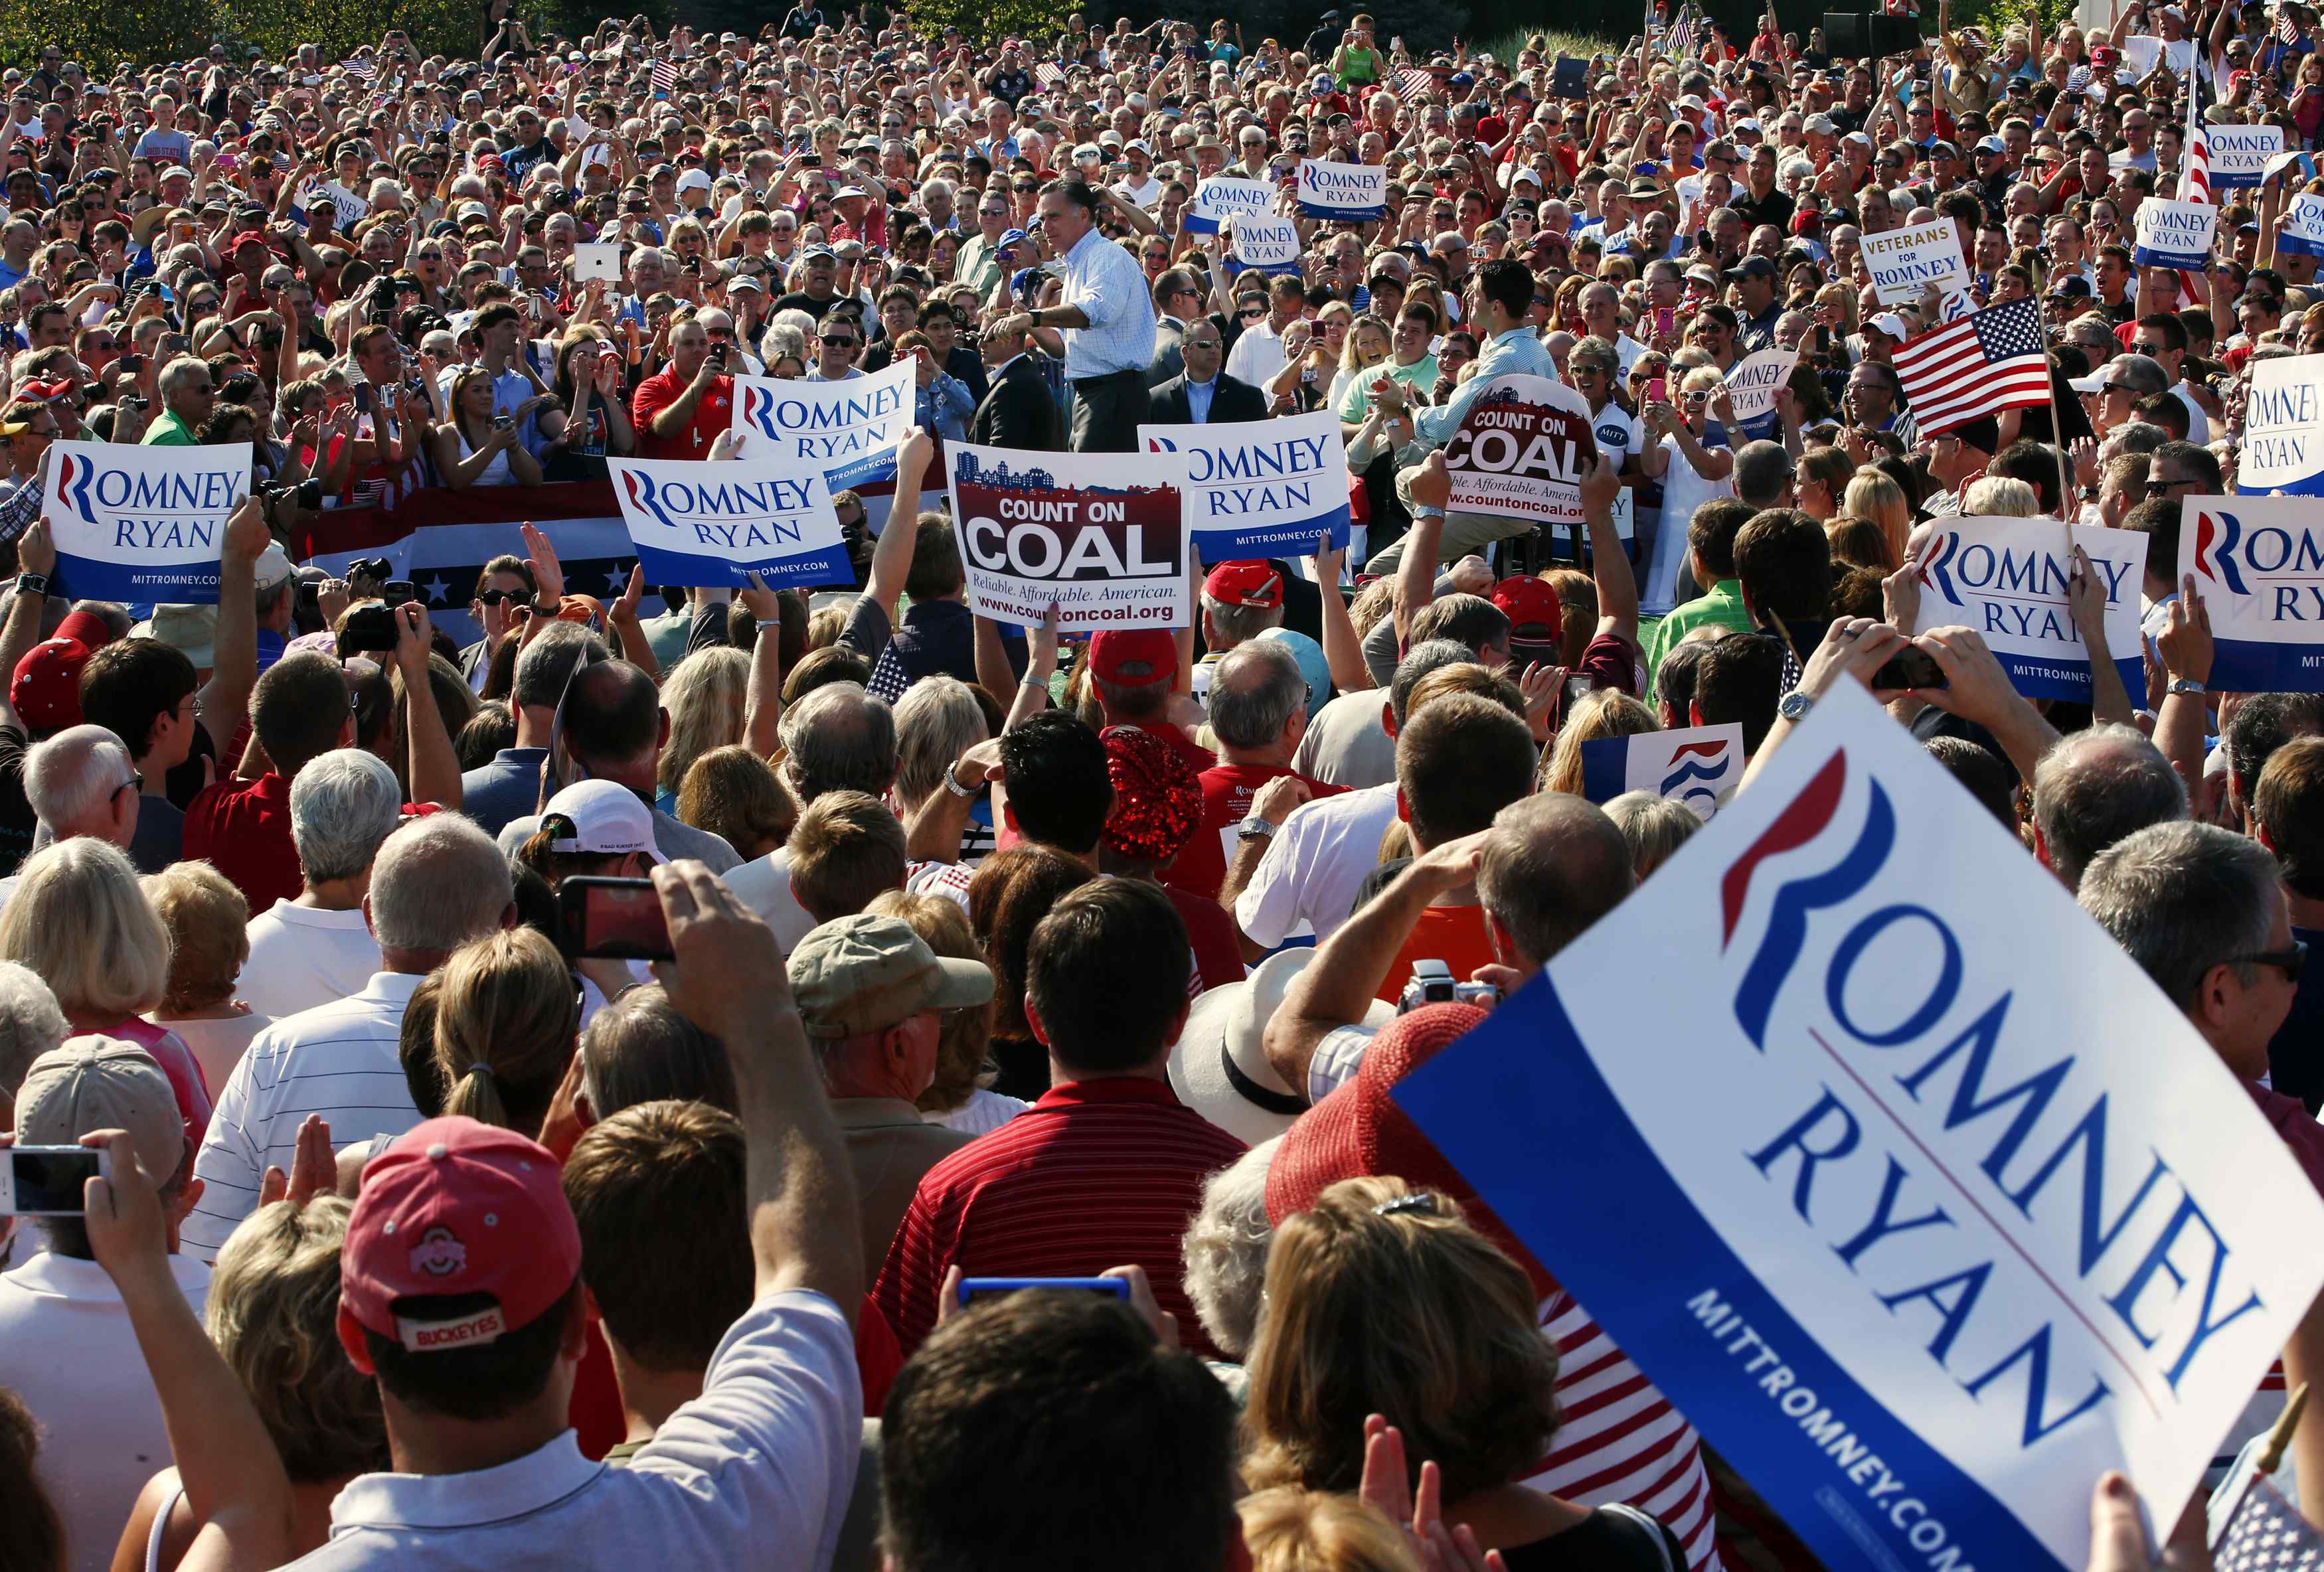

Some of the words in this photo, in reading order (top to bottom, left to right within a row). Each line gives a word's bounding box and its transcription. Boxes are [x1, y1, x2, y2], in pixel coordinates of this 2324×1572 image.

[1304, 165, 1381, 193] ROMNEY
[1201, 183, 1271, 207] ROMNEY
[1327, 191, 1370, 202] RYAN
[2145, 203, 2210, 232] ROMNEY
[1244, 246, 1286, 258] RYAN
[1866, 226, 1949, 254] VETERANS
[2153, 231, 2197, 248] RYAN
[1874, 256, 1957, 286] ROMNEY
[1898, 252, 1917, 263] FOR
[2159, 255, 2201, 265] MITTROMNEY.COM
[744, 379, 907, 441] ROMNEY
[1475, 411, 1535, 430] COUNT
[1541, 417, 1566, 436] ON
[798, 423, 886, 458] RYAN
[1601, 428, 1624, 441] MITT
[1445, 429, 1580, 484] COAL
[2253, 435, 2306, 469] RYAN
[825, 456, 896, 483] ITTROMNEY.COM
[58, 453, 243, 524] ROMNEY
[621, 469, 815, 527] ROMNEY
[1206, 482, 1311, 516] RYAN
[1473, 477, 1537, 495] Affordable.
[999, 498, 1078, 522] COUNT
[1088, 502, 1125, 522] ON
[114, 519, 216, 548] RYAN
[692, 519, 801, 548] RYAN
[965, 516, 1173, 578] COAL
[1236, 528, 1332, 545] MITTROMNEY.COM
[1918, 531, 2134, 607] ROMNY
[973, 573, 1016, 596] Reliable.
[1019, 584, 1093, 603] Affordable.
[1099, 584, 1177, 601] American.
[2014, 665, 2092, 683] MITTROMNEY
[1722, 746, 2265, 1399] ROMNEY
[1744, 1081, 2116, 1449] RYAN
[417, 1315, 498, 1346] BUCKEYES
